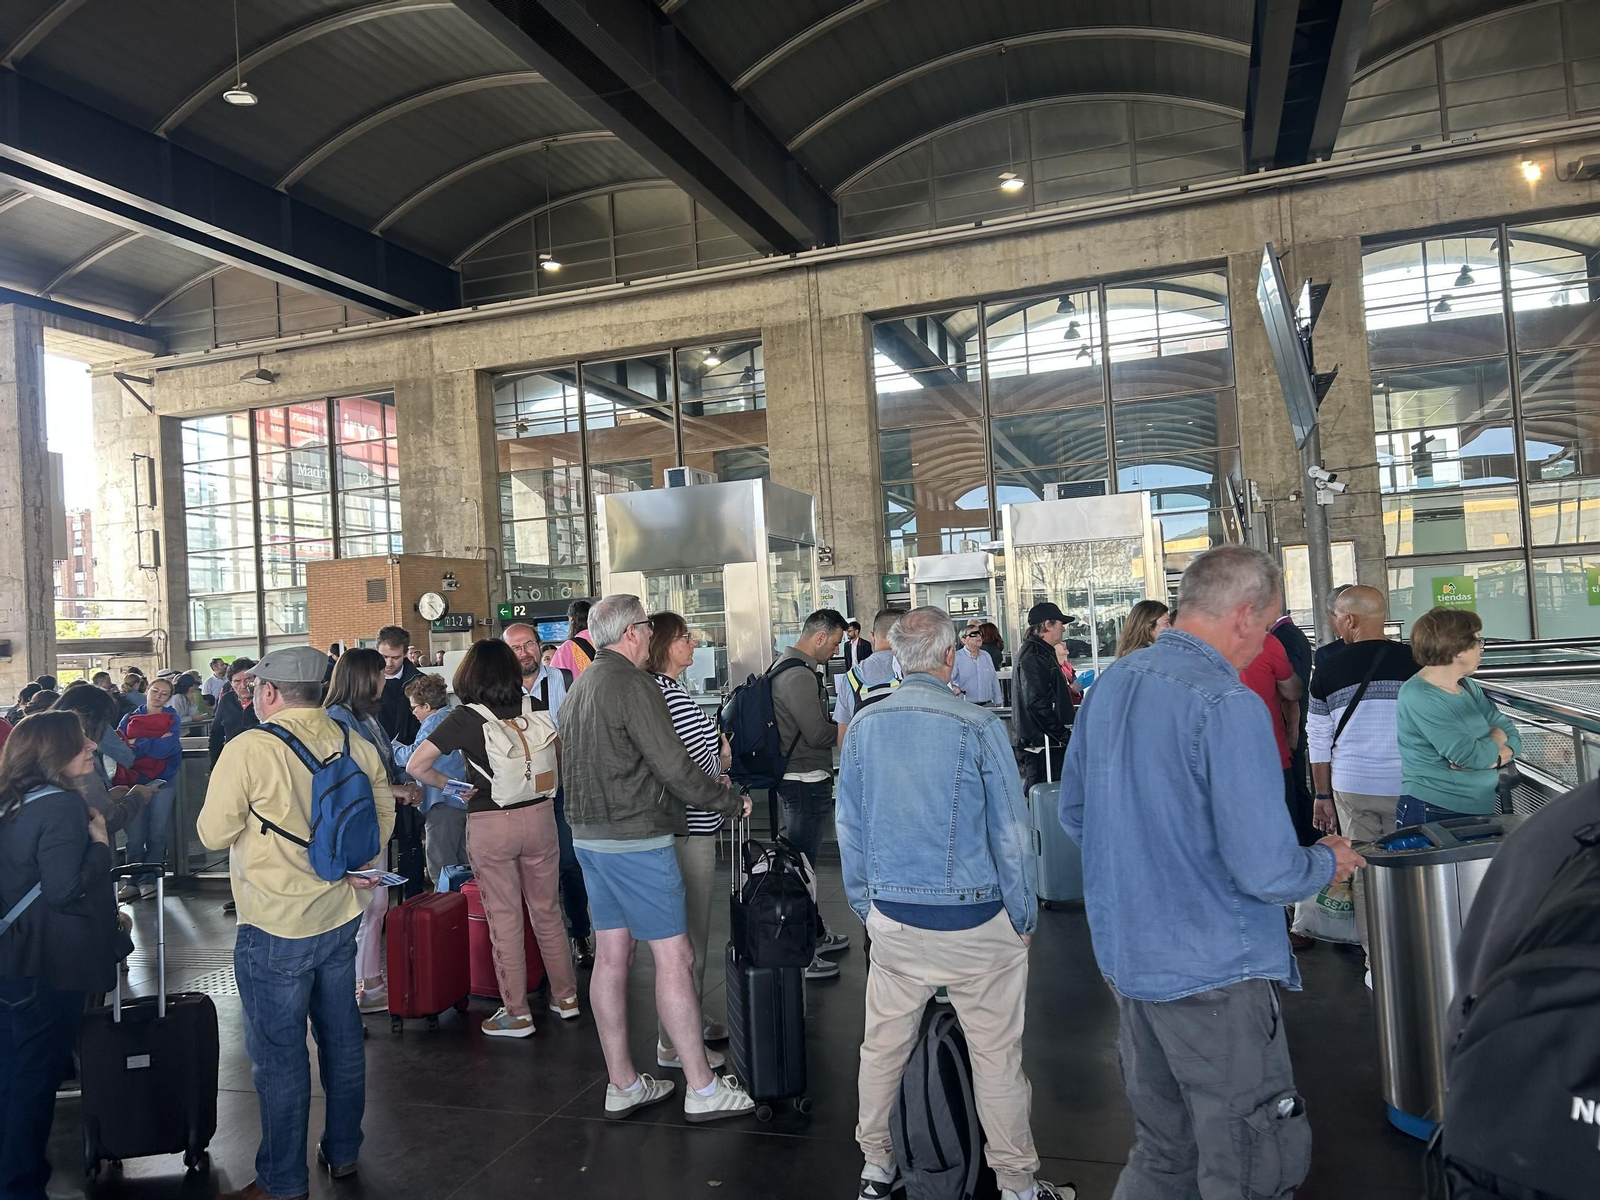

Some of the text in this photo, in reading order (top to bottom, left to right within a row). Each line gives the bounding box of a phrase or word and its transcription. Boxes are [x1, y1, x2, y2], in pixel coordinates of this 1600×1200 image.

[344, 413, 379, 445] iryo
[298, 462, 329, 479] Madri
[1437, 593, 1472, 602] tiendas
[513, 605, 526, 616] P2
[1570, 1096, 1600, 1126] N
